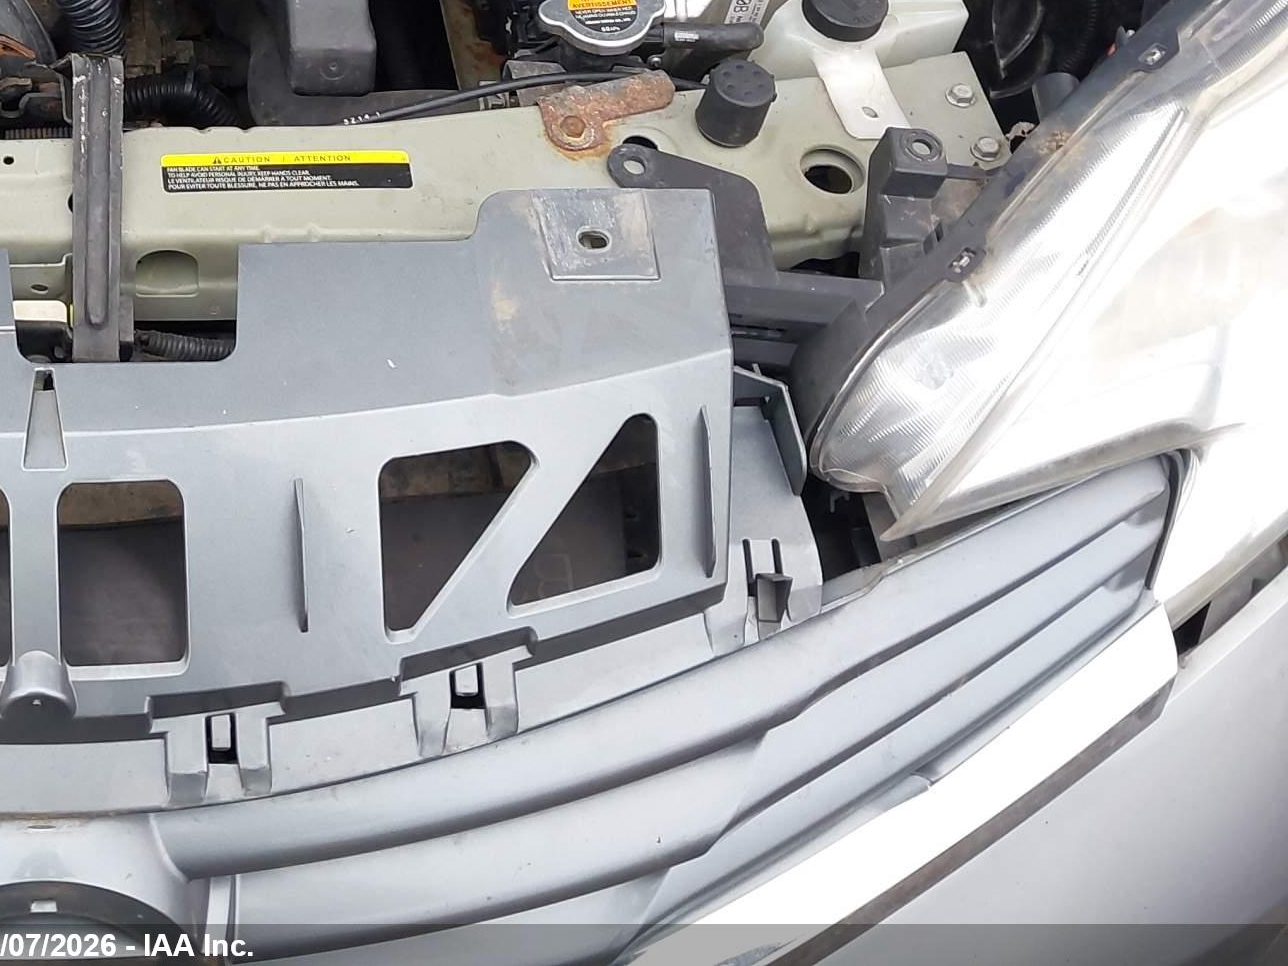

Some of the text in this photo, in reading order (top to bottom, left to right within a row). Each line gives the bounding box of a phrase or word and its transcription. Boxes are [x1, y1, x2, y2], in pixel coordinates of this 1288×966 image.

[572, 0, 633, 8] AVERTISSEMENT
[223, 156, 271, 164] CAUTION
[294, 154, 351, 163] ATTENTION
